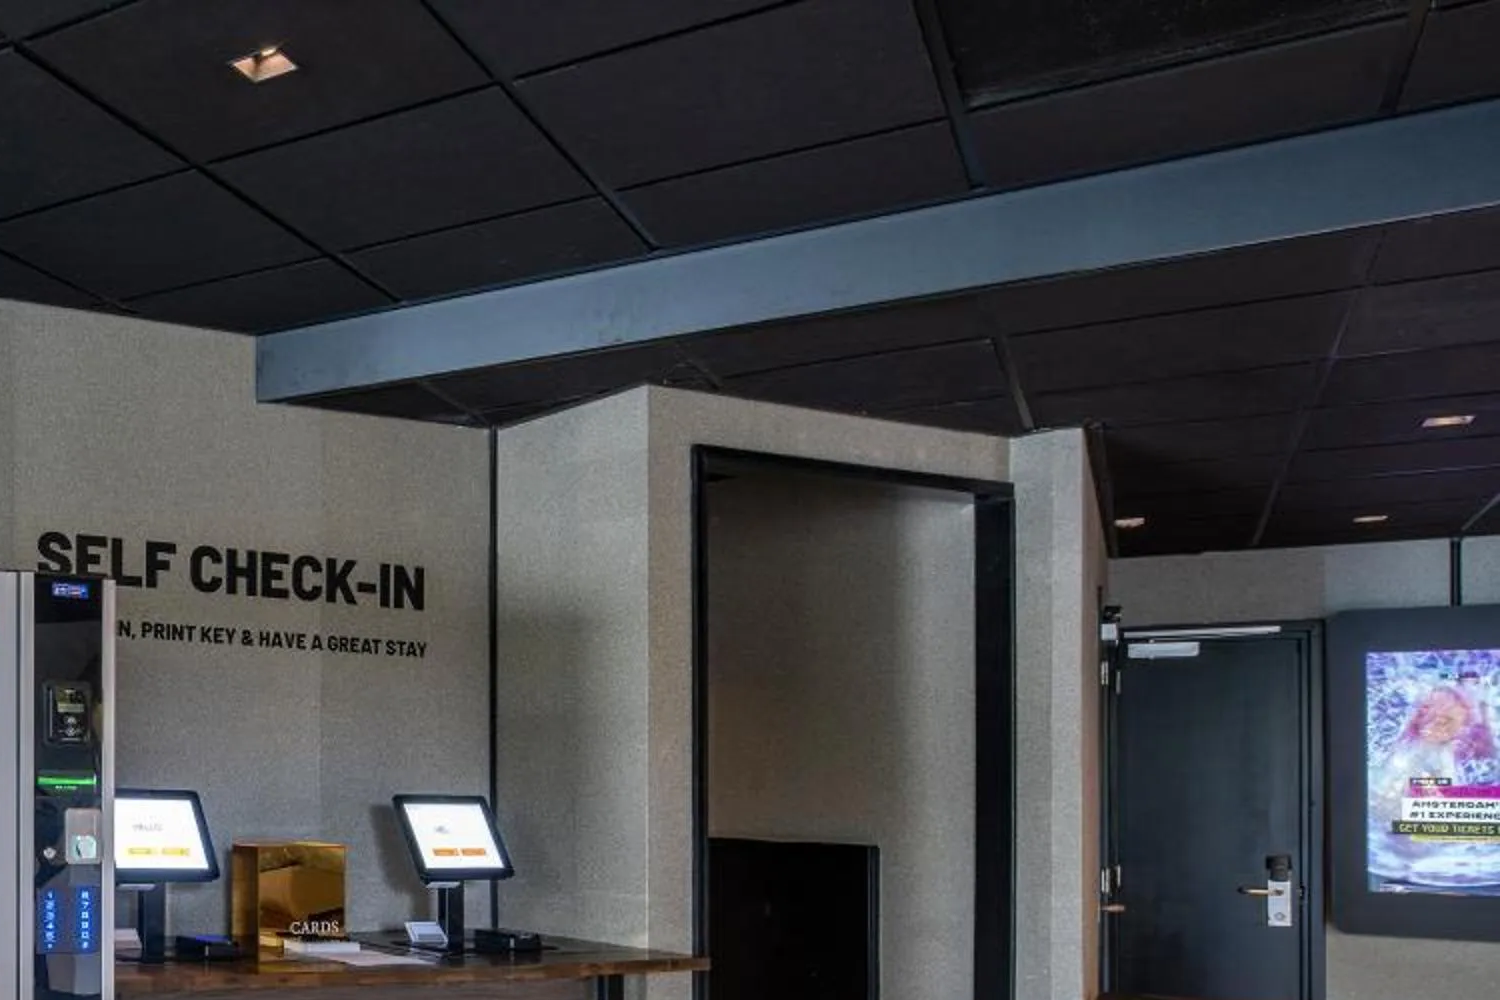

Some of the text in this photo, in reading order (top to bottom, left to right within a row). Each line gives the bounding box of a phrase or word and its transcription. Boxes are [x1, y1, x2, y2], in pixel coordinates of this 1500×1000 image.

[37, 531, 425, 611] SELF CHECK-IN
[117, 620, 428, 658] N, PRINT KEY & HAVE A GREAT STAY
[1399, 824, 1419, 833] GET
[290, 920, 340, 935] CARDS
